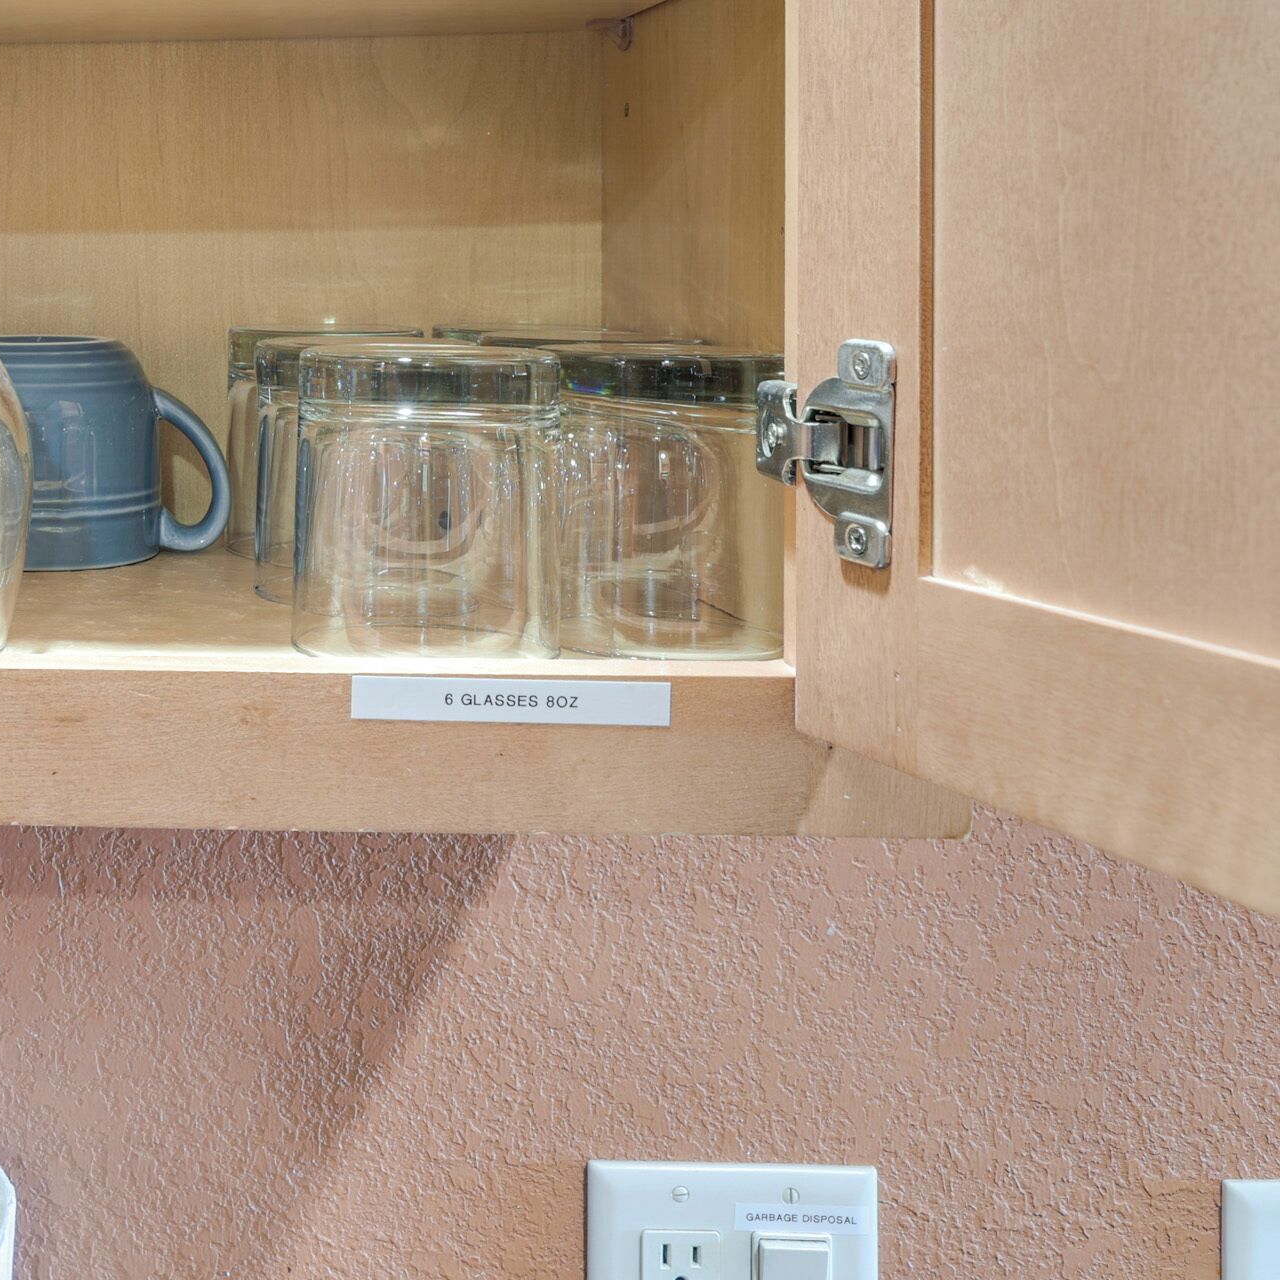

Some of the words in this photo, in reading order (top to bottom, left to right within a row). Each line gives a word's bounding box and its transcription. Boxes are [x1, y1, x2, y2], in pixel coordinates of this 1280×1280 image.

[445, 693, 453, 706] 6
[461, 694, 538, 707] GLASSES
[746, 1212, 798, 1223] GARBAGE
[802, 1215, 857, 1225] DISPOSAL
